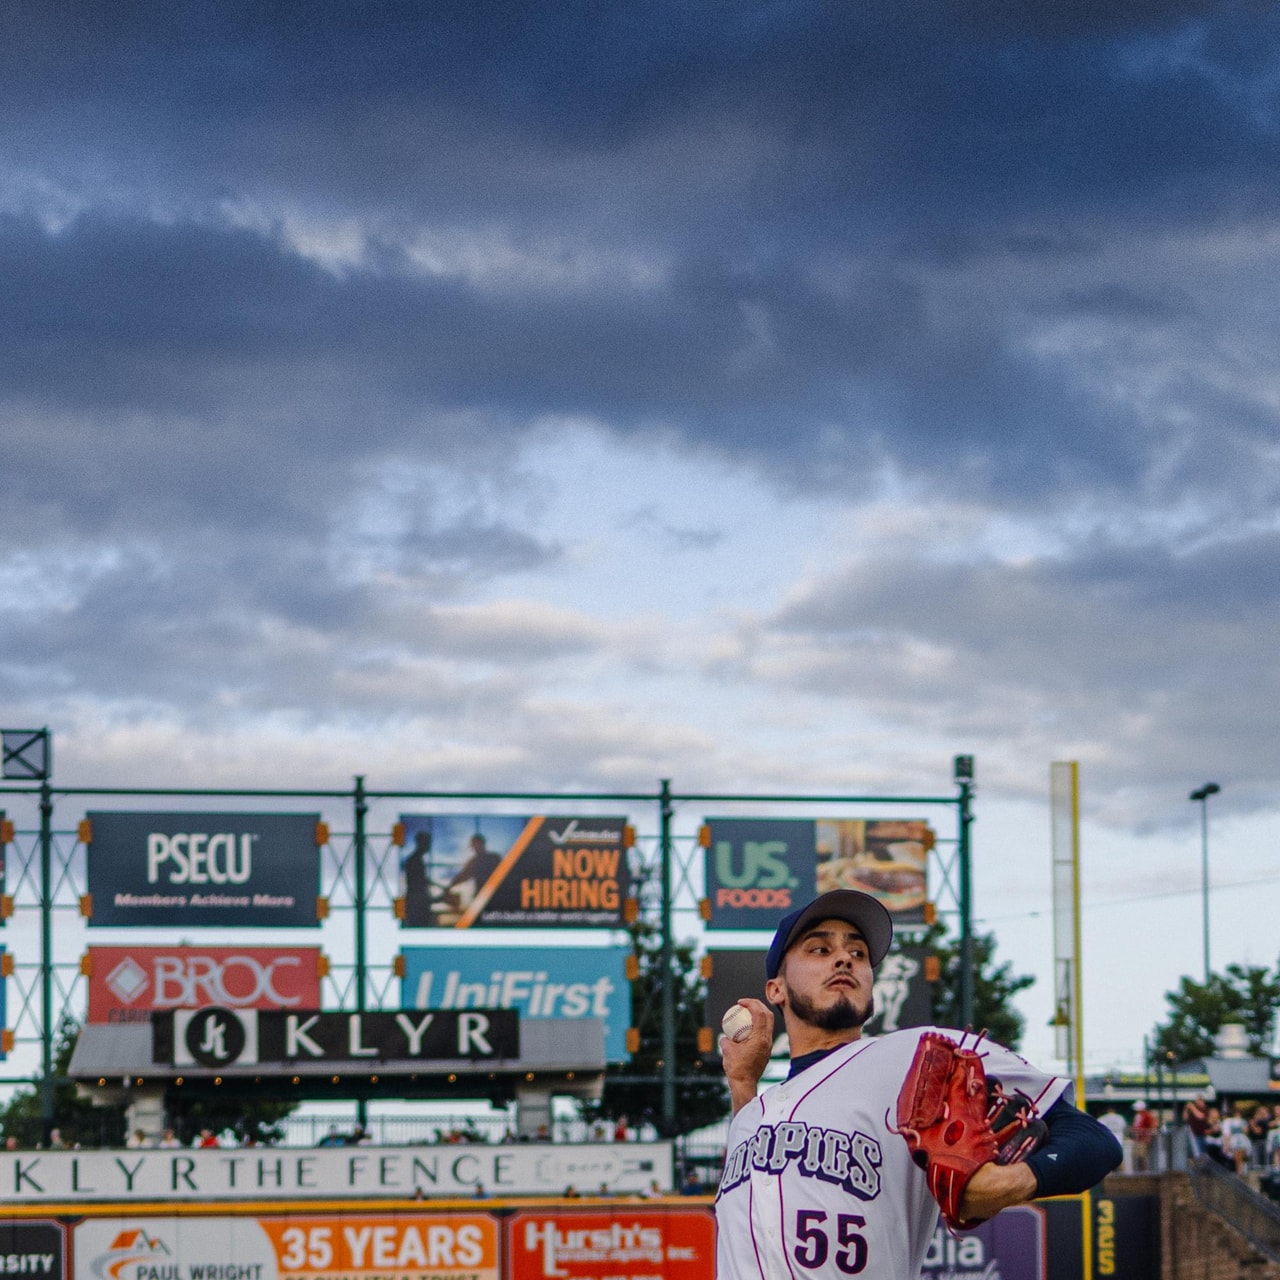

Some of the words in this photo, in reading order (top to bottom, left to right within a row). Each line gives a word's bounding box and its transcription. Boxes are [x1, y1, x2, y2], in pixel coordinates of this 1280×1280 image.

[148, 833, 252, 884] PSECU
[554, 848, 620, 878] NOW
[521, 878, 620, 909] HIRING
[716, 888, 792, 908] FOODS
[416, 971, 614, 1016] UniFirst
[286, 1013, 493, 1056] KLYR
[14, 1157, 198, 1193] KLYR
[222, 1157, 318, 1187] THE
[349, 1154, 515, 1185] FENCE
[715, 1121, 883, 1202] ONPIGS
[281, 1227, 334, 1269] 35
[344, 1225, 484, 1268] YEARS
[794, 1209, 869, 1275] 55
